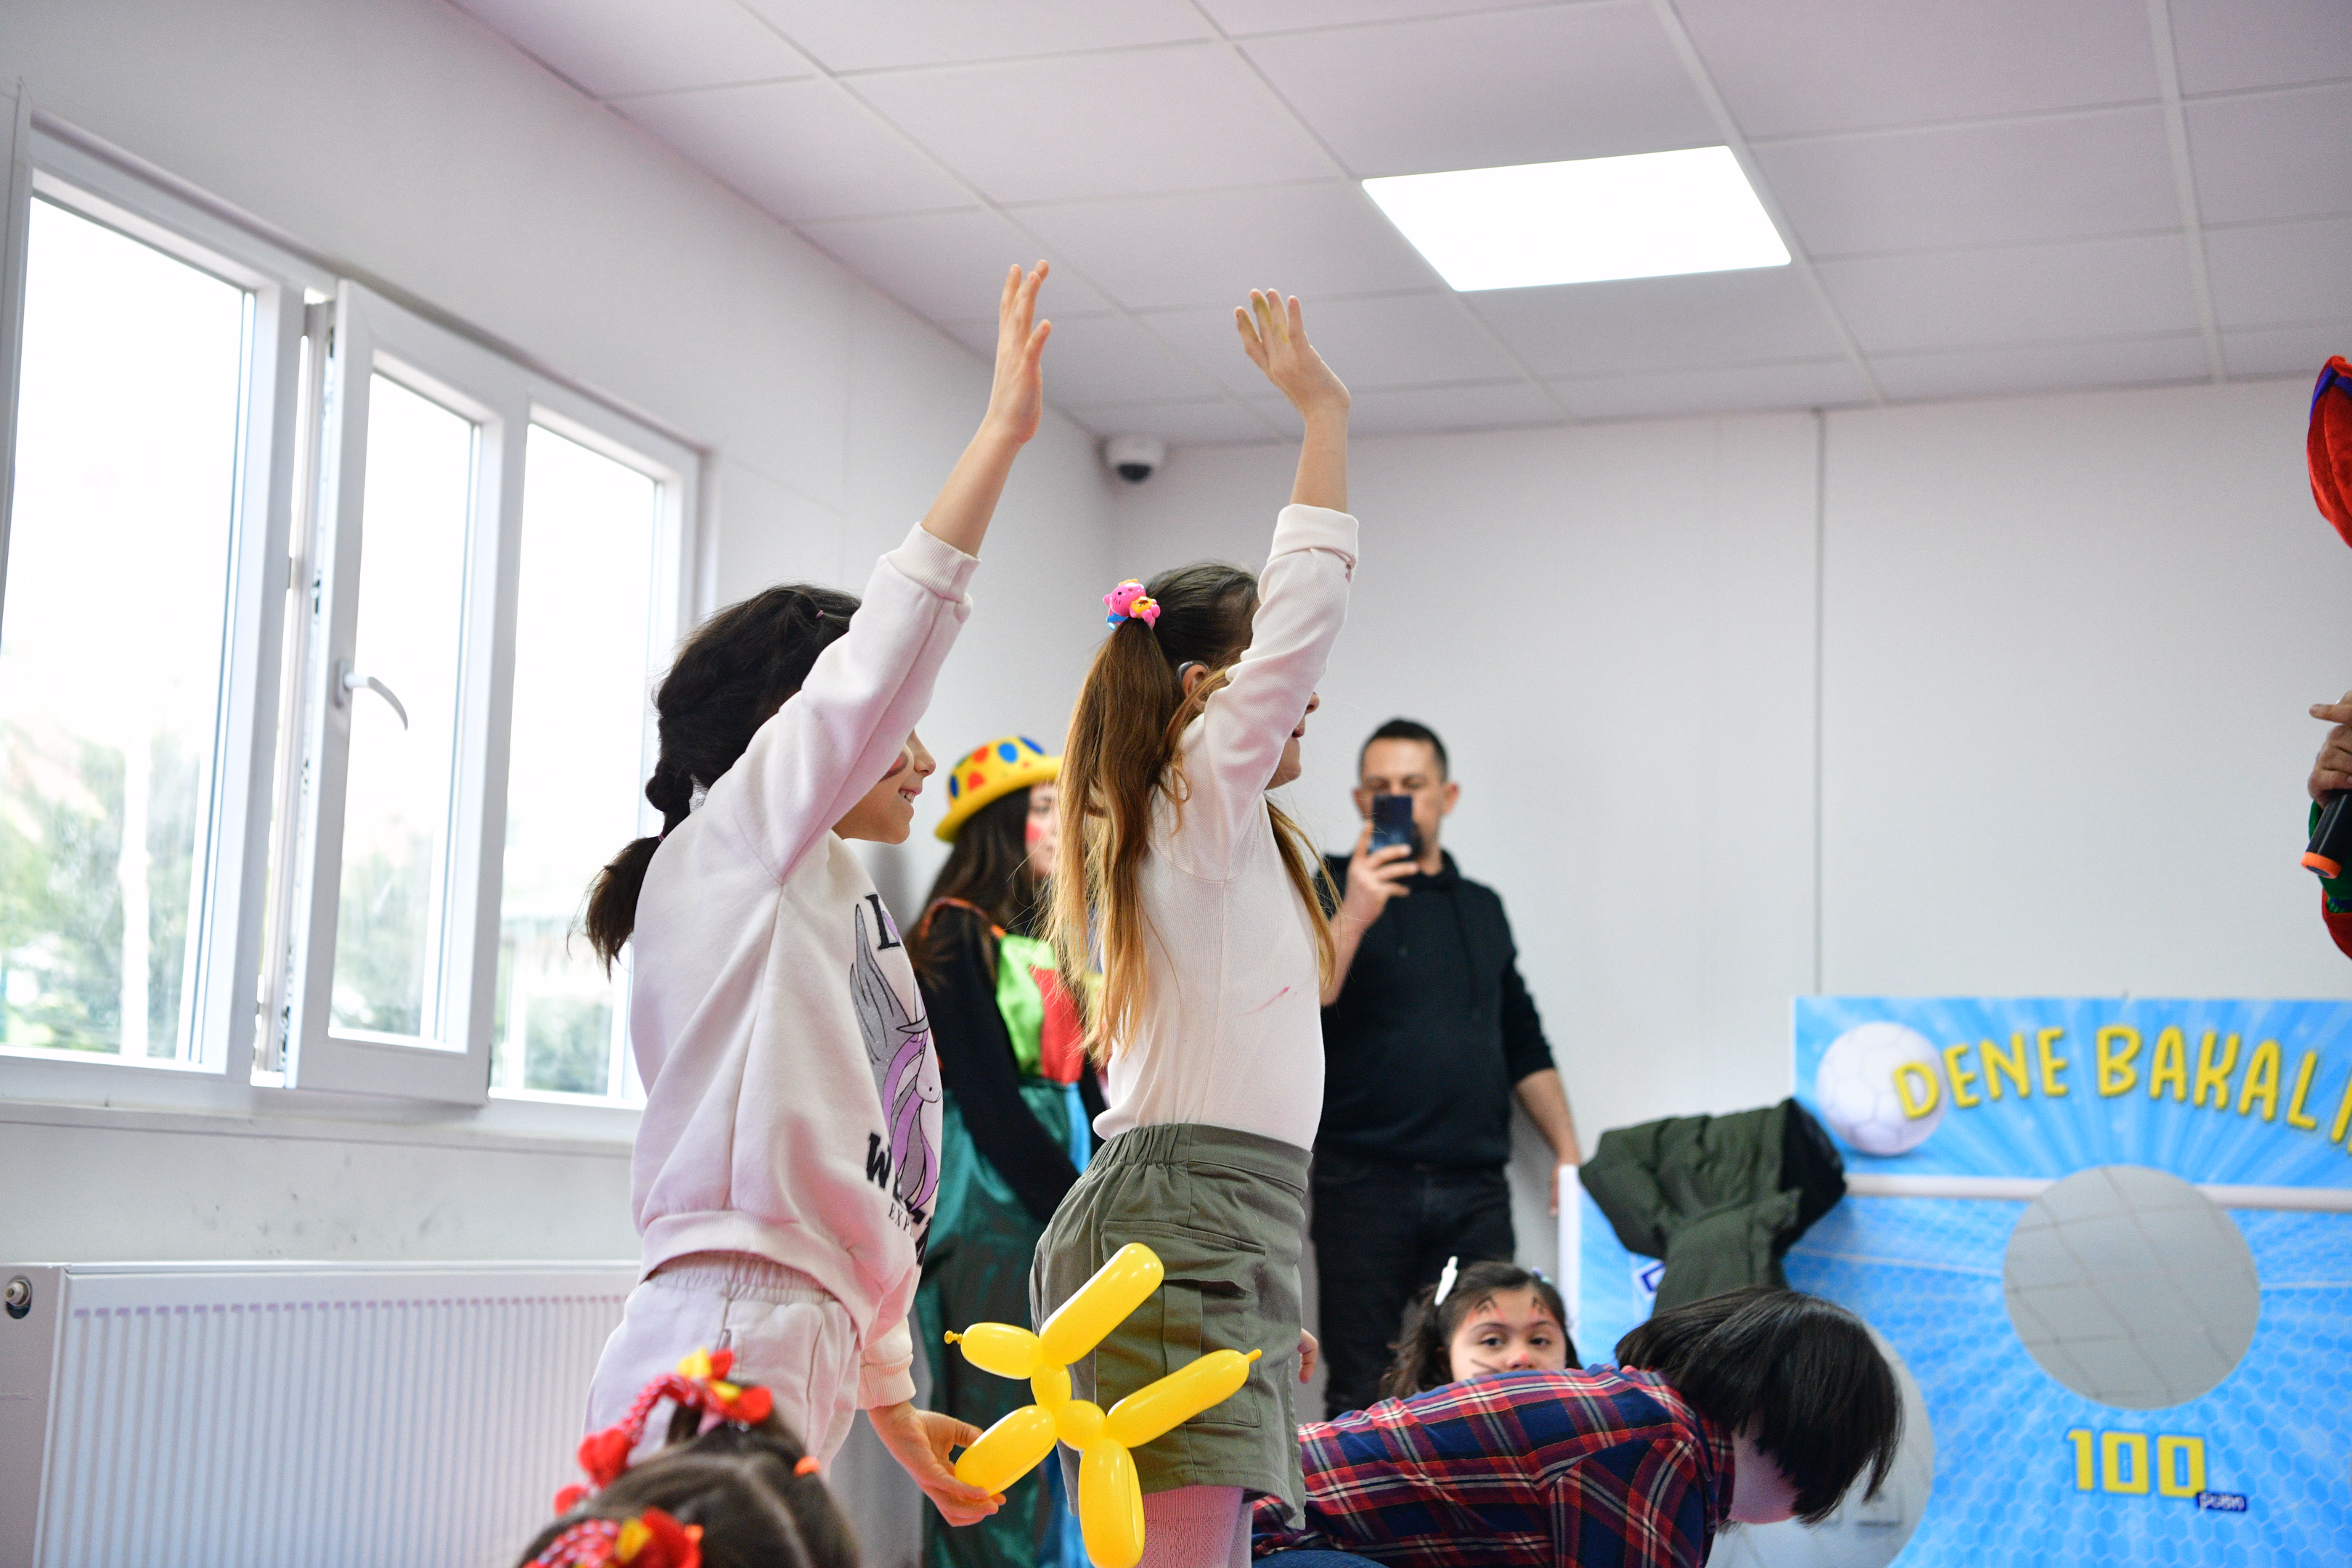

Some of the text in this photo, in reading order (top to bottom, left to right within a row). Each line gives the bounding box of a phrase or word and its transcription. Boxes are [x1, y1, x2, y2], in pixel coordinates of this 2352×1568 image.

[1892, 1025, 2352, 1154] DENE BAKALI
[2067, 1429, 2206, 1498] 100
